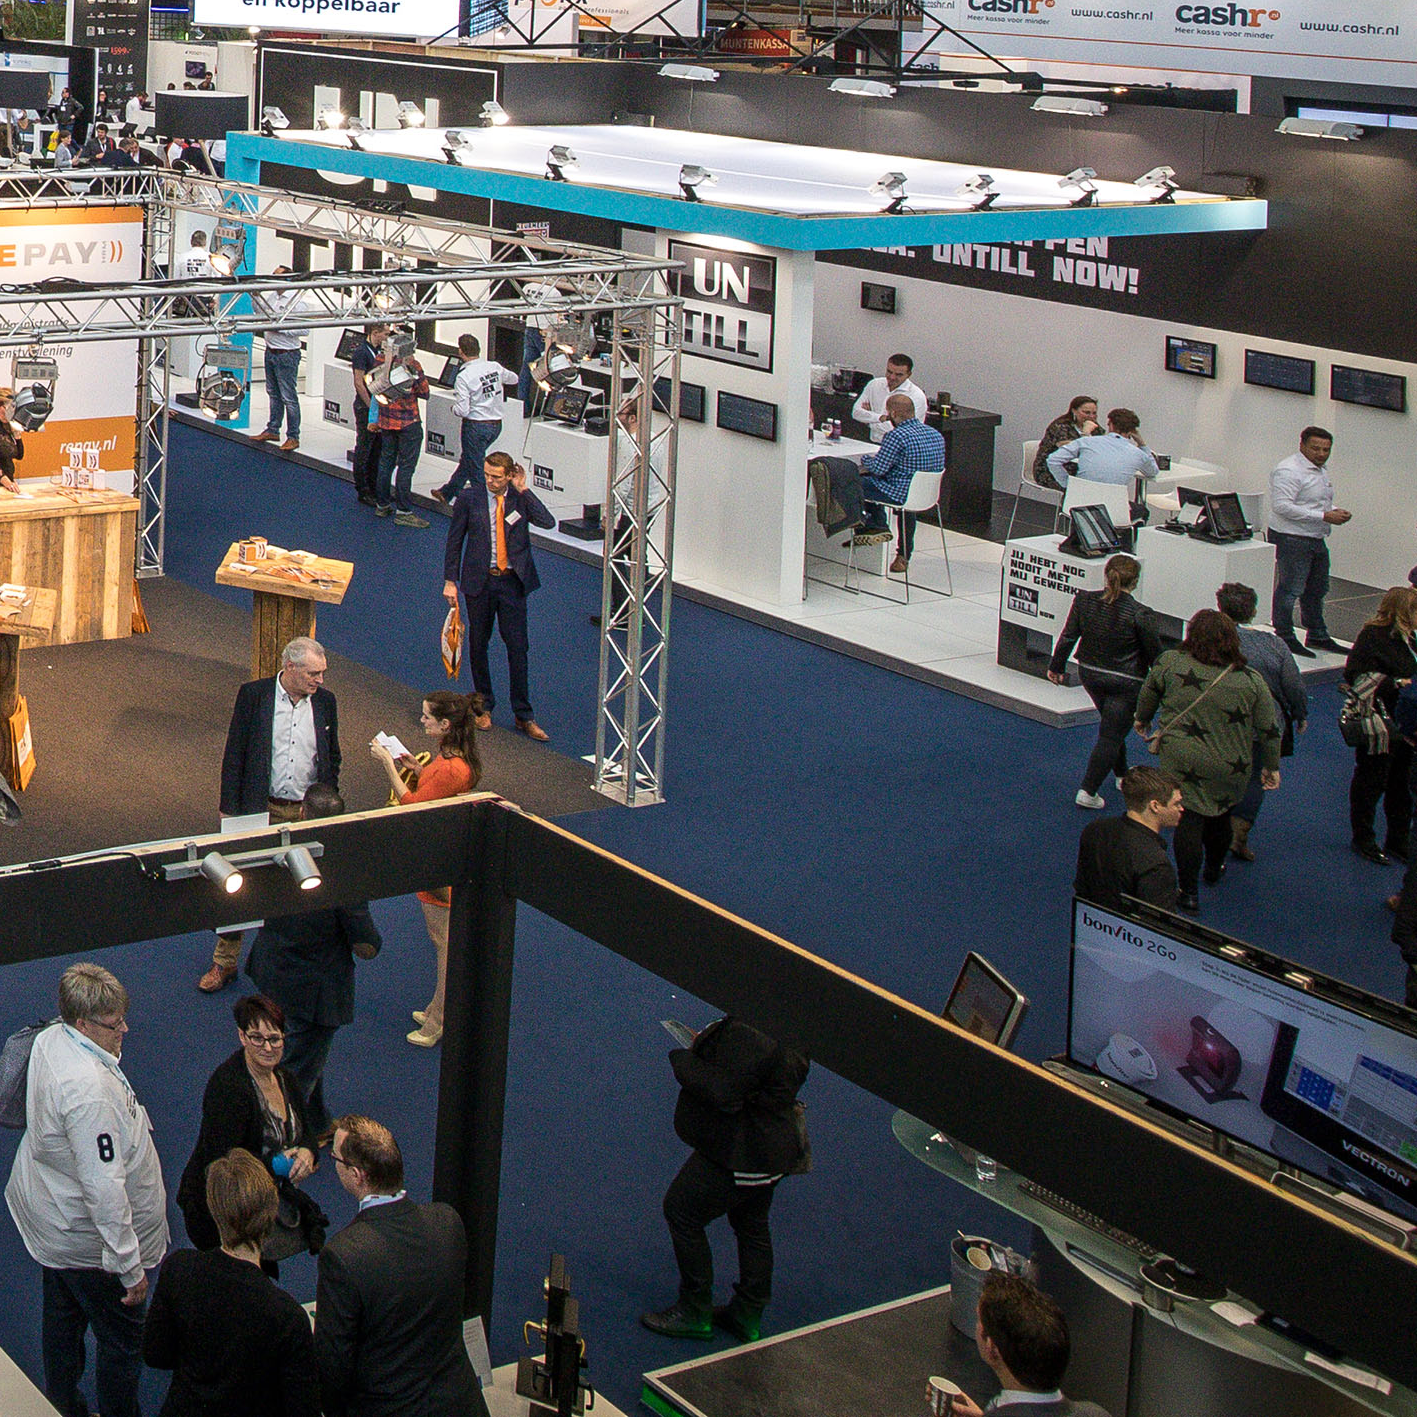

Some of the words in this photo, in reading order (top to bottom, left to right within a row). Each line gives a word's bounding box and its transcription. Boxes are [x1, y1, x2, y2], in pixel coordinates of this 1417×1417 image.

[985, 15, 1005, 23] kassa
[1024, 17, 1050, 25] minder
[1071, 8, 1154, 21] www.cashr.nl
[1176, 3, 1266, 28] cashr
[1175, 26, 1194, 34] Meer
[1197, 28, 1221, 37] kassa
[1244, 31, 1275, 40] minder
[1300, 21, 1399, 36] www.cashr.nl
[720, 36, 790, 50] MUNTENKASSA
[932, 243, 1035, 277] UNTILL
[693, 257, 750, 305] UN
[1052, 256, 1139, 294] NOW!
[683, 308, 760, 358] TILL
[1010, 559, 1042, 575] NOOIT
[1048, 570, 1070, 583] MET
[1011, 550, 1024, 560] JIJ
[1030, 554, 1057, 569] HEBT
[1062, 564, 1085, 578] NOG
[1010, 569, 1027, 581] MIJ
[1033, 575, 1079, 595] GEWERK
[1015, 587, 1032, 601] UN
[1011, 598, 1035, 614] TILL
[1083, 912, 1144, 948] bonVito
[1147, 940, 1177, 962] 2Go
[96, 1132, 115, 1163] 8
[1342, 1139, 1410, 1188] VECTRON
